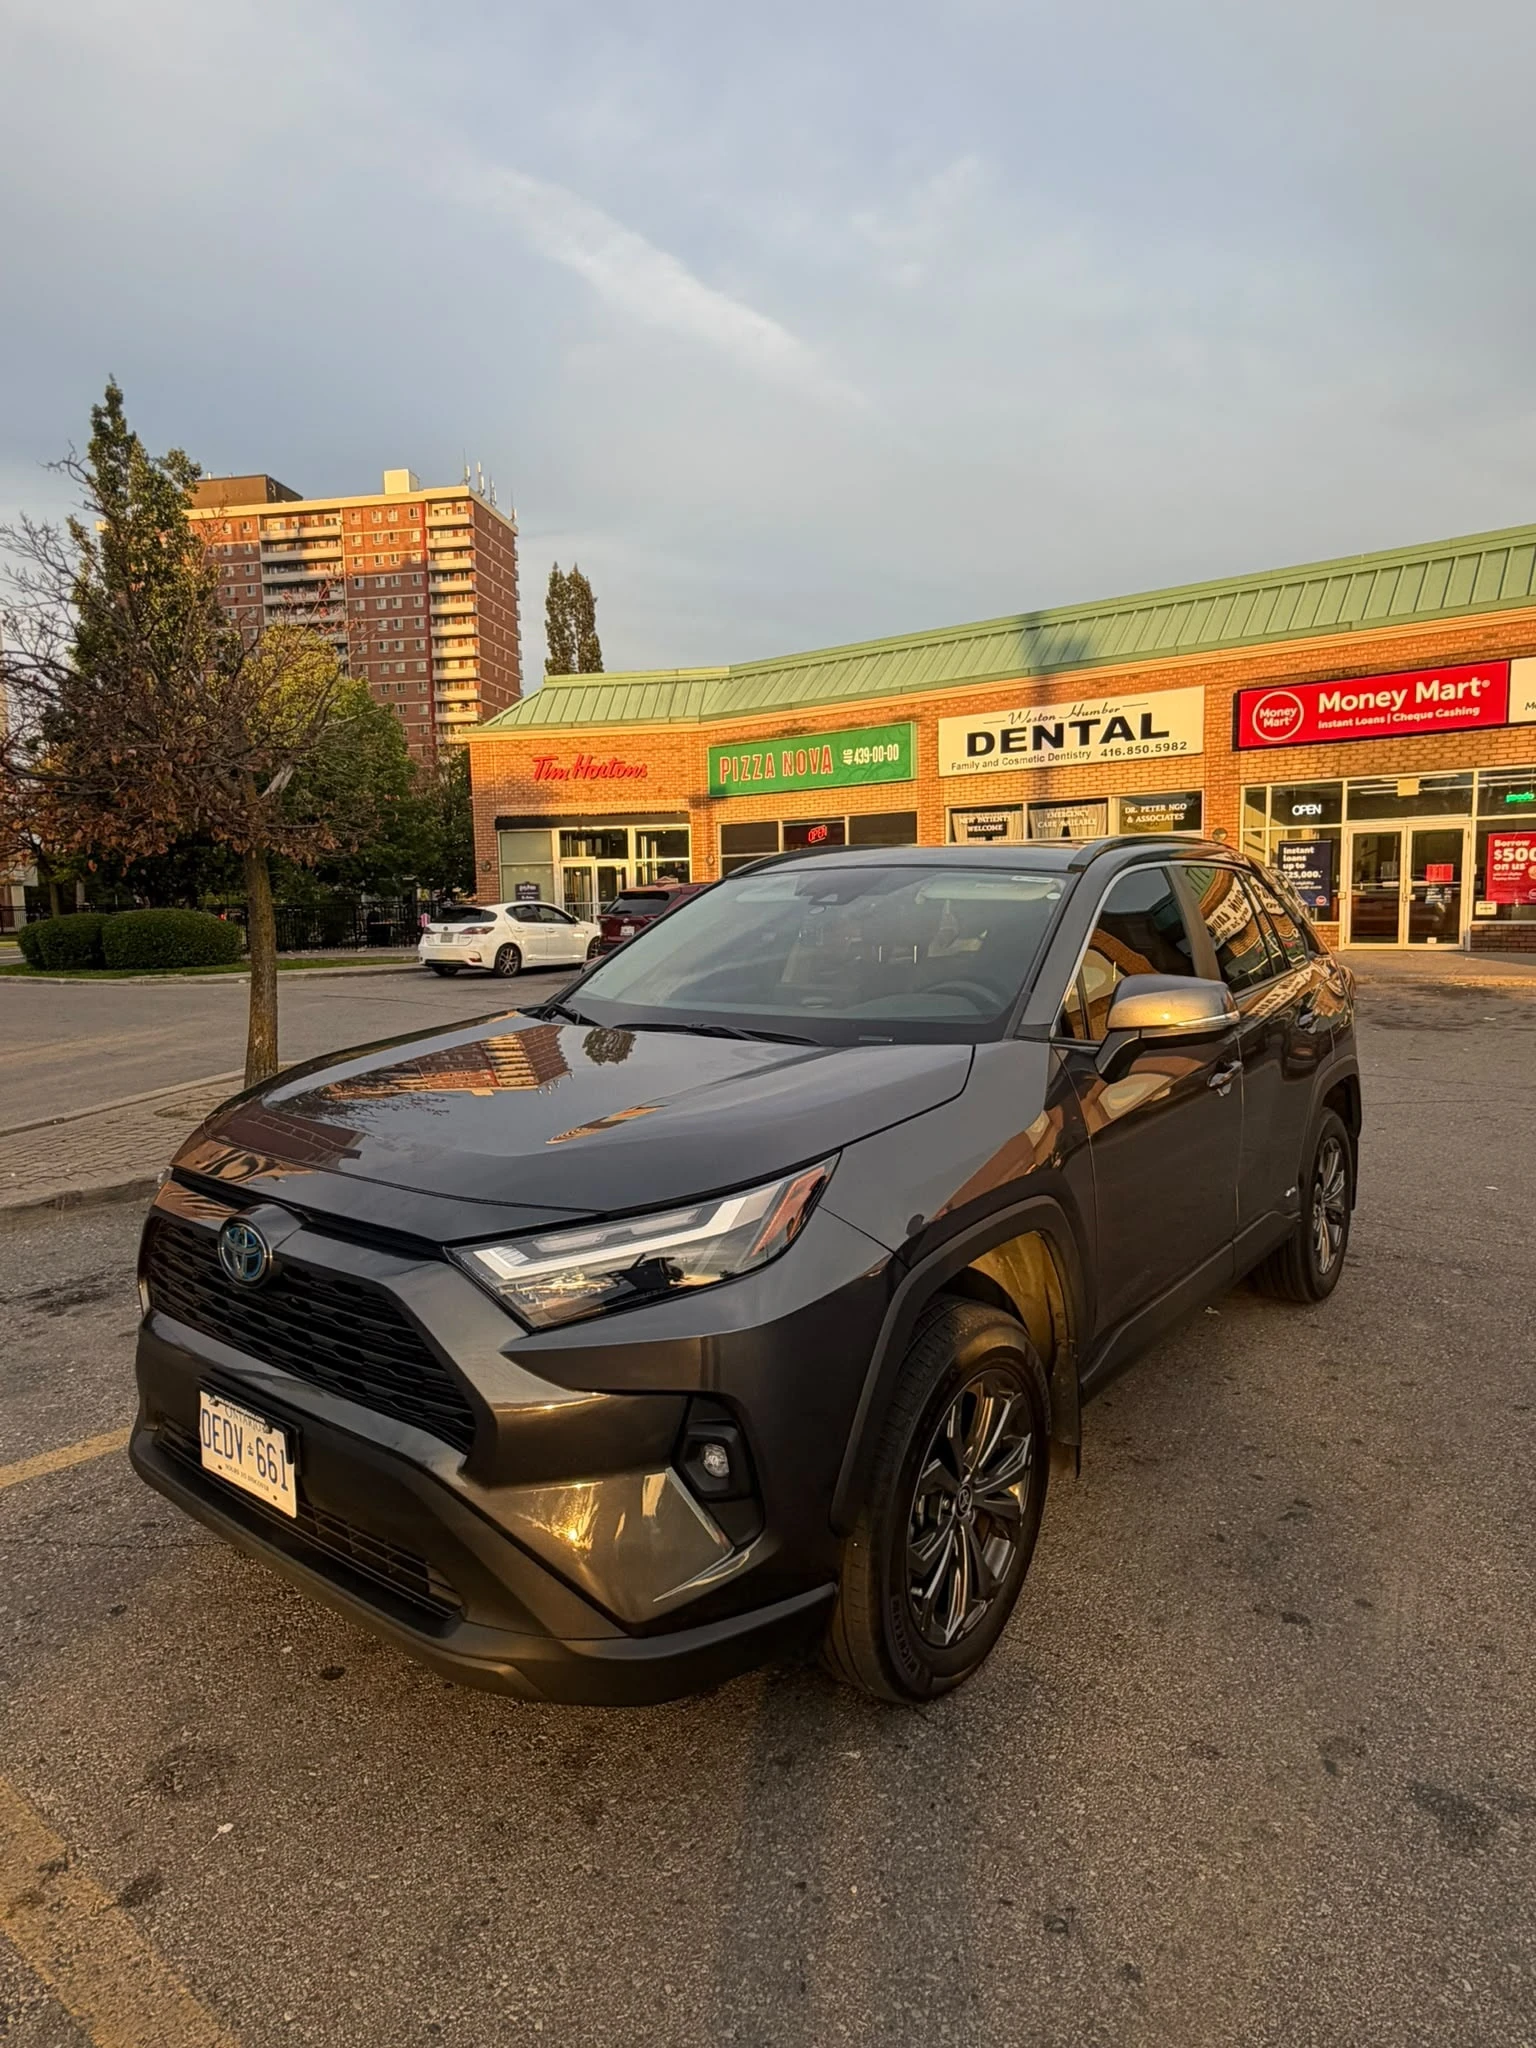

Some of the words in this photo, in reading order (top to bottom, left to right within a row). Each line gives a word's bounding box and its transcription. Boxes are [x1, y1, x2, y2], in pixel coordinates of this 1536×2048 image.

[1318, 688, 1408, 714] Money
[1008, 710, 1056, 725] Weston
[1059, 702, 1120, 719] Humber
[1260, 707, 1298, 719] Money
[1318, 718, 1353, 729] Instant
[1355, 716, 1385, 725] Loans
[1392, 712, 1433, 723] Cheque
[1435, 706, 1480, 718] Cashing
[967, 712, 1169, 757] DENTAL
[951, 761, 980, 771] Family
[982, 758, 999, 768] and
[1002, 754, 1045, 766] Cosmetic
[1047, 750, 1092, 762] Dentistry
[1100, 741, 1187, 757] 416.850.5982
[532, 754, 570, 781] Tim
[571, 753, 648, 780] Hortons
[719, 752, 776, 784] PIZZA
[782, 745, 834, 777] NOVA
[843, 749, 853, 765] 416
[854, 743, 899, 765] 439-00-00
[1047, 810, 1089, 818] EMERGENCY
[1124, 806, 1138, 814] DR.
[1141, 804, 1166, 813] PETER
[1169, 802, 1188, 811] NGO
[1292, 804, 1322, 816] OPEN
[959, 816, 975, 824] NEW
[977, 815, 1012, 823] PATIENTS
[1059, 818, 1097, 827] AVAILABLE
[1135, 813, 1185, 823] ASSOCIATES
[808, 826, 827, 842] OPEN
[967, 824, 1004, 832] WELCOME
[1494, 839, 1531, 847] Borrow
[1283, 846, 1314, 854] Instant
[1283, 854, 1307, 862] loans
[1493, 863, 1509, 871] on
[256, 1436, 289, 1492] 661
